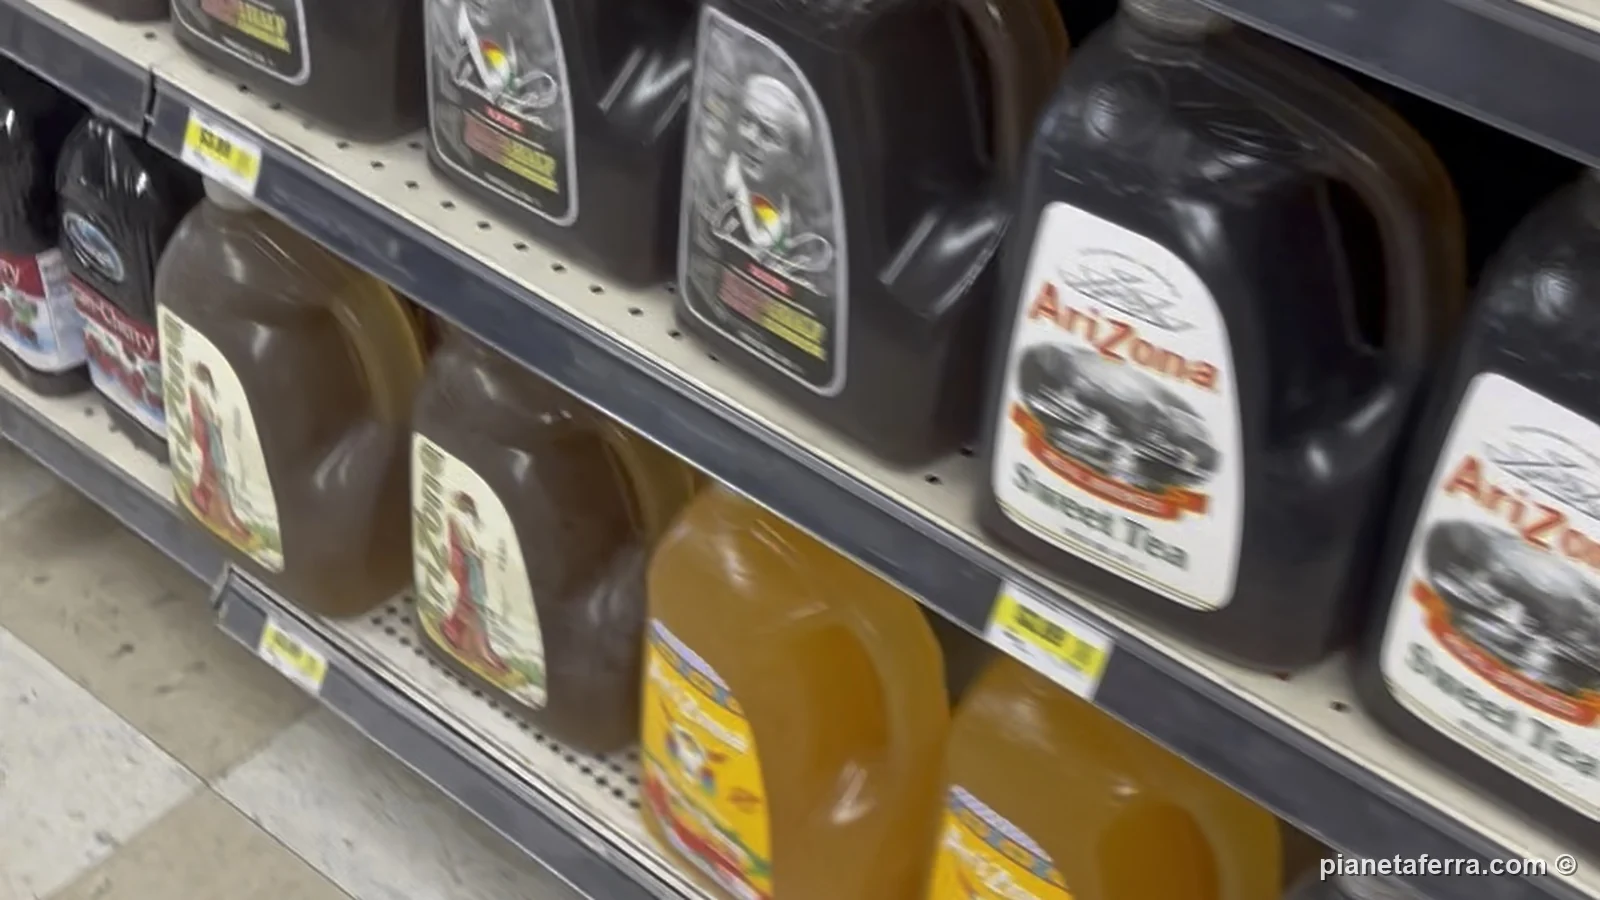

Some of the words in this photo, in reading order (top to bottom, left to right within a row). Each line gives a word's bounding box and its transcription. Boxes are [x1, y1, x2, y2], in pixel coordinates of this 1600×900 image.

[1028, 281, 1221, 395] AriZona
[1011, 461, 1116, 541] Sweet
[1124, 516, 1190, 571] Tea
[1444, 455, 1600, 572] AriZo
[1404, 641, 1518, 736] Sweet
